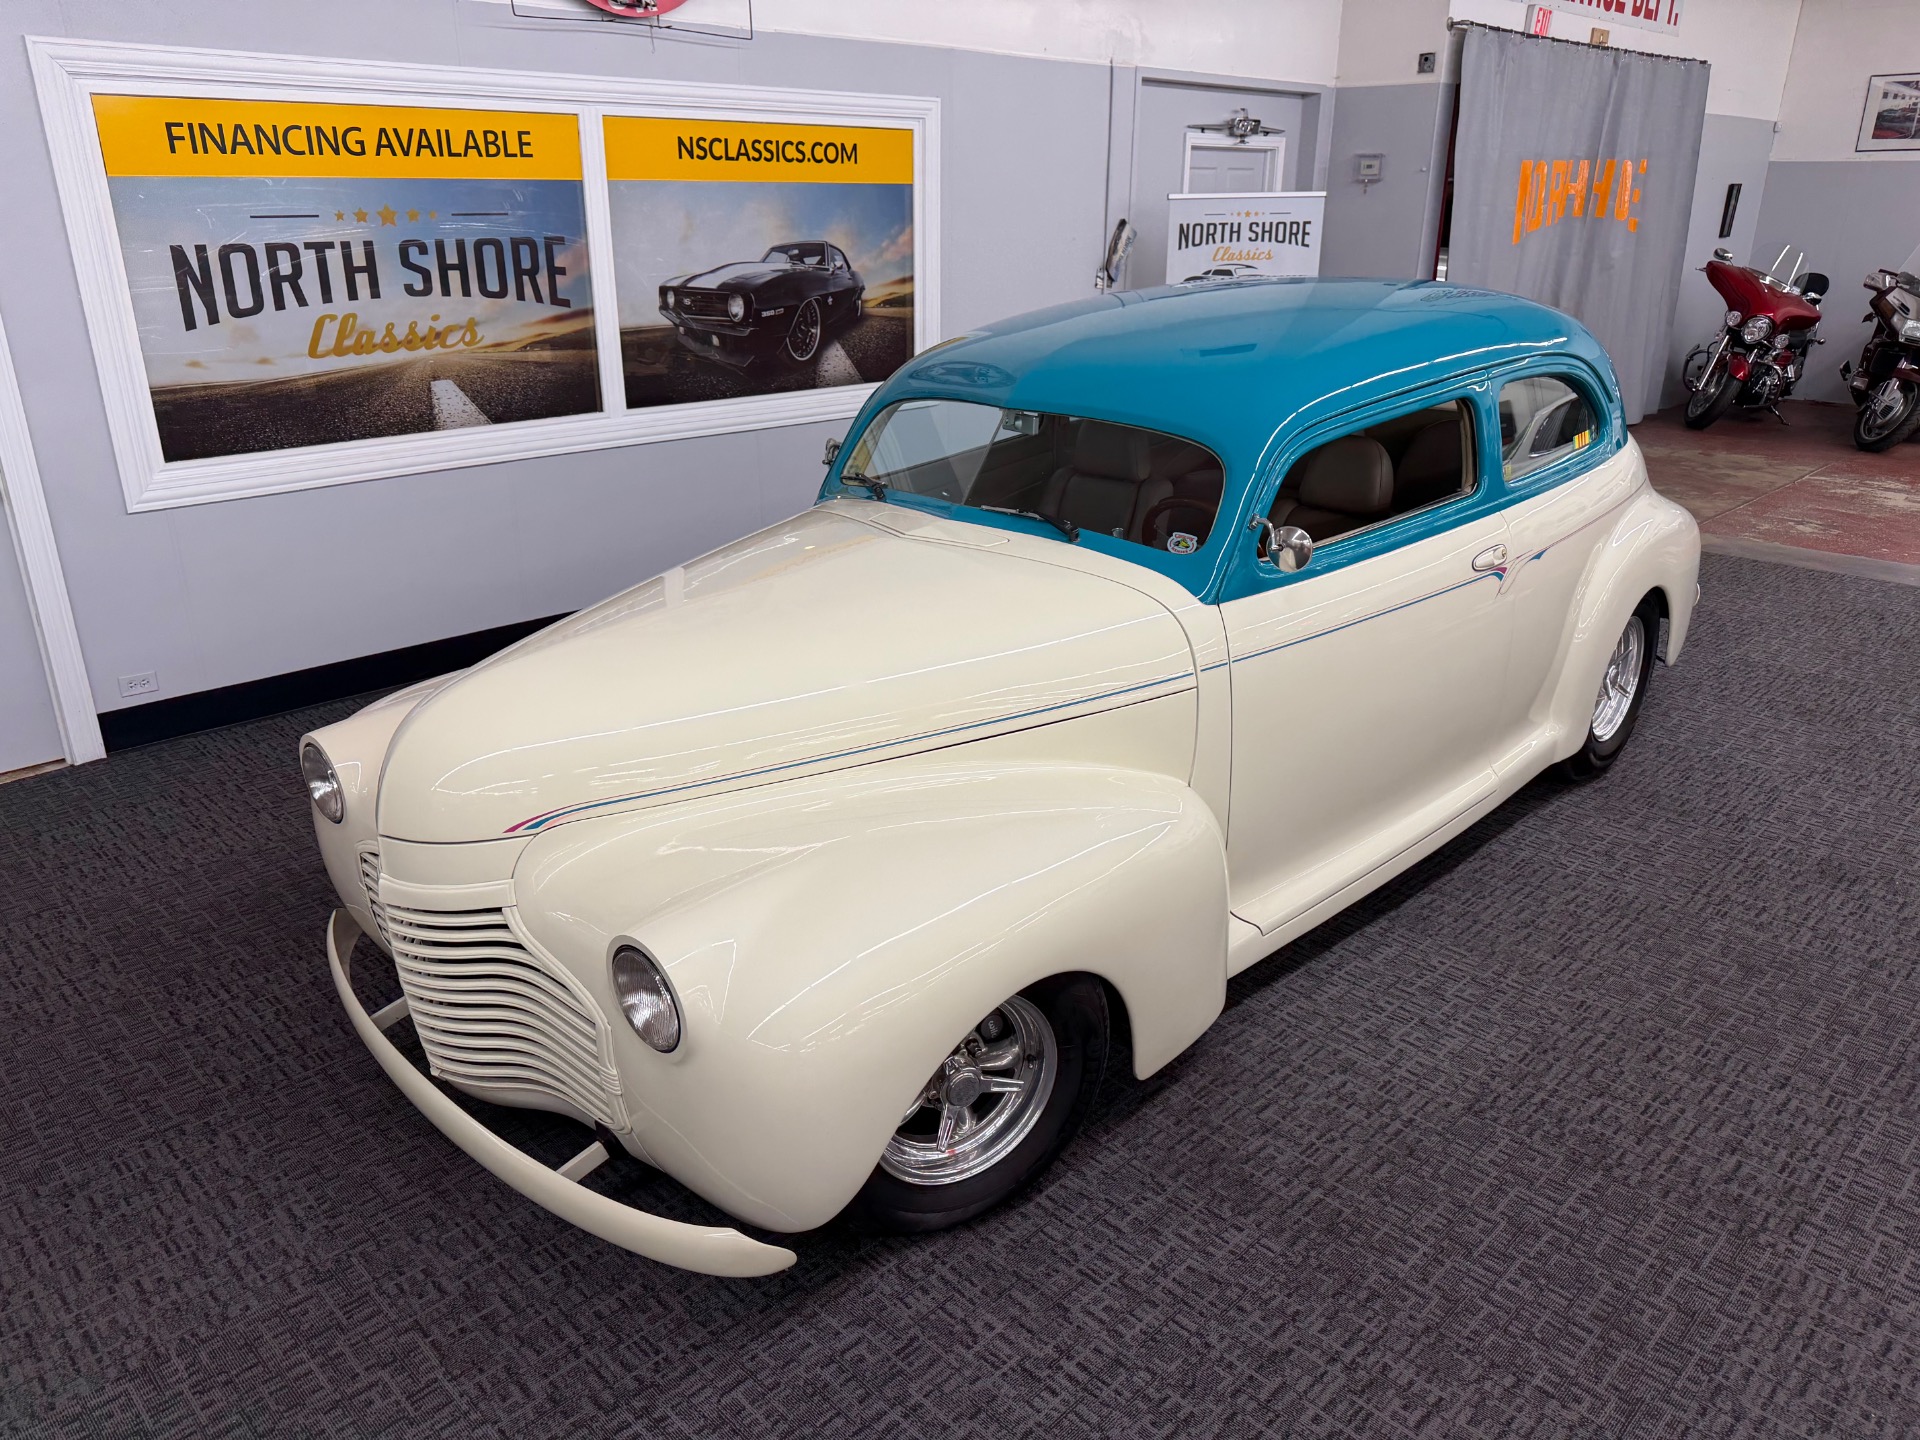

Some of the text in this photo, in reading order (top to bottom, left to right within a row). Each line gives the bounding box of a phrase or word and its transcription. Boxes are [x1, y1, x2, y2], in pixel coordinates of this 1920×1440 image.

[1534, 7, 1552, 36] EXIT
[164, 121, 534, 159] FINANCING AVAILABLE
[677, 136, 858, 164] NSCLASSICS.COM
[1178, 220, 1312, 251] NORTH SHORE
[1211, 246, 1274, 262] Classics
[169, 236, 572, 332] NORTH SHORE
[307, 313, 485, 360] Classics
